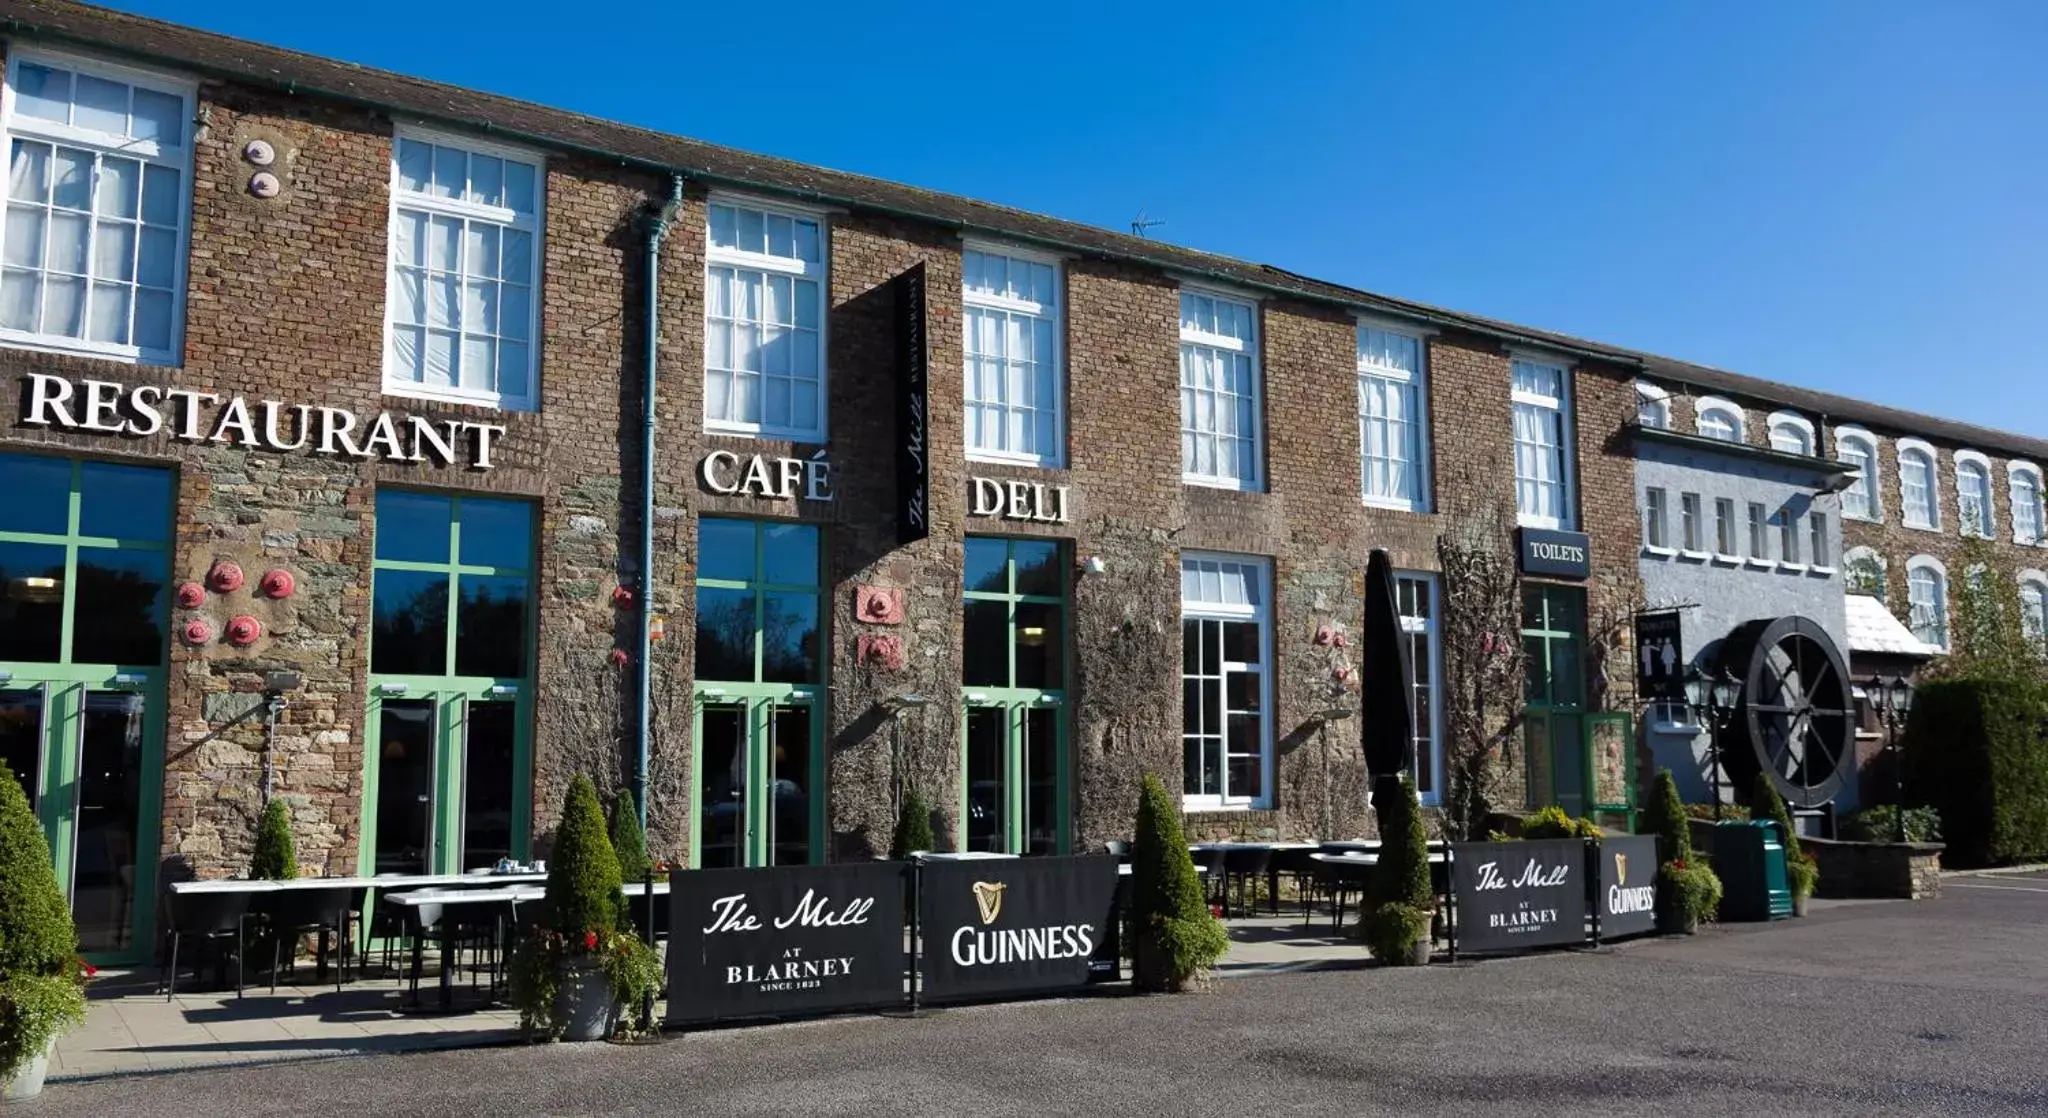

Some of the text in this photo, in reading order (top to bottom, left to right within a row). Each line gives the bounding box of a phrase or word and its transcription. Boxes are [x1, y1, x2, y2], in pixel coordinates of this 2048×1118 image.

[23, 372, 505, 468] RESTAURANT
[907, 392, 922, 474] Mill
[703, 449, 834, 502] CAFÉ
[908, 483, 923, 529] The
[971, 476, 1070, 522] DELI
[1530, 541, 1584, 563] TOILETS
[1475, 858, 1569, 892] The Mill
[703, 888, 874, 934] The Mill
[1519, 902, 1529, 910] AT
[1609, 884, 1654, 915] GUINNESS
[1490, 909, 1558, 927] BLARNEY
[783, 948, 802, 958] AT
[952, 924, 1094, 966] GUINNESS
[726, 957, 855, 984] BLARNEY
[760, 982, 793, 992] SINCE
